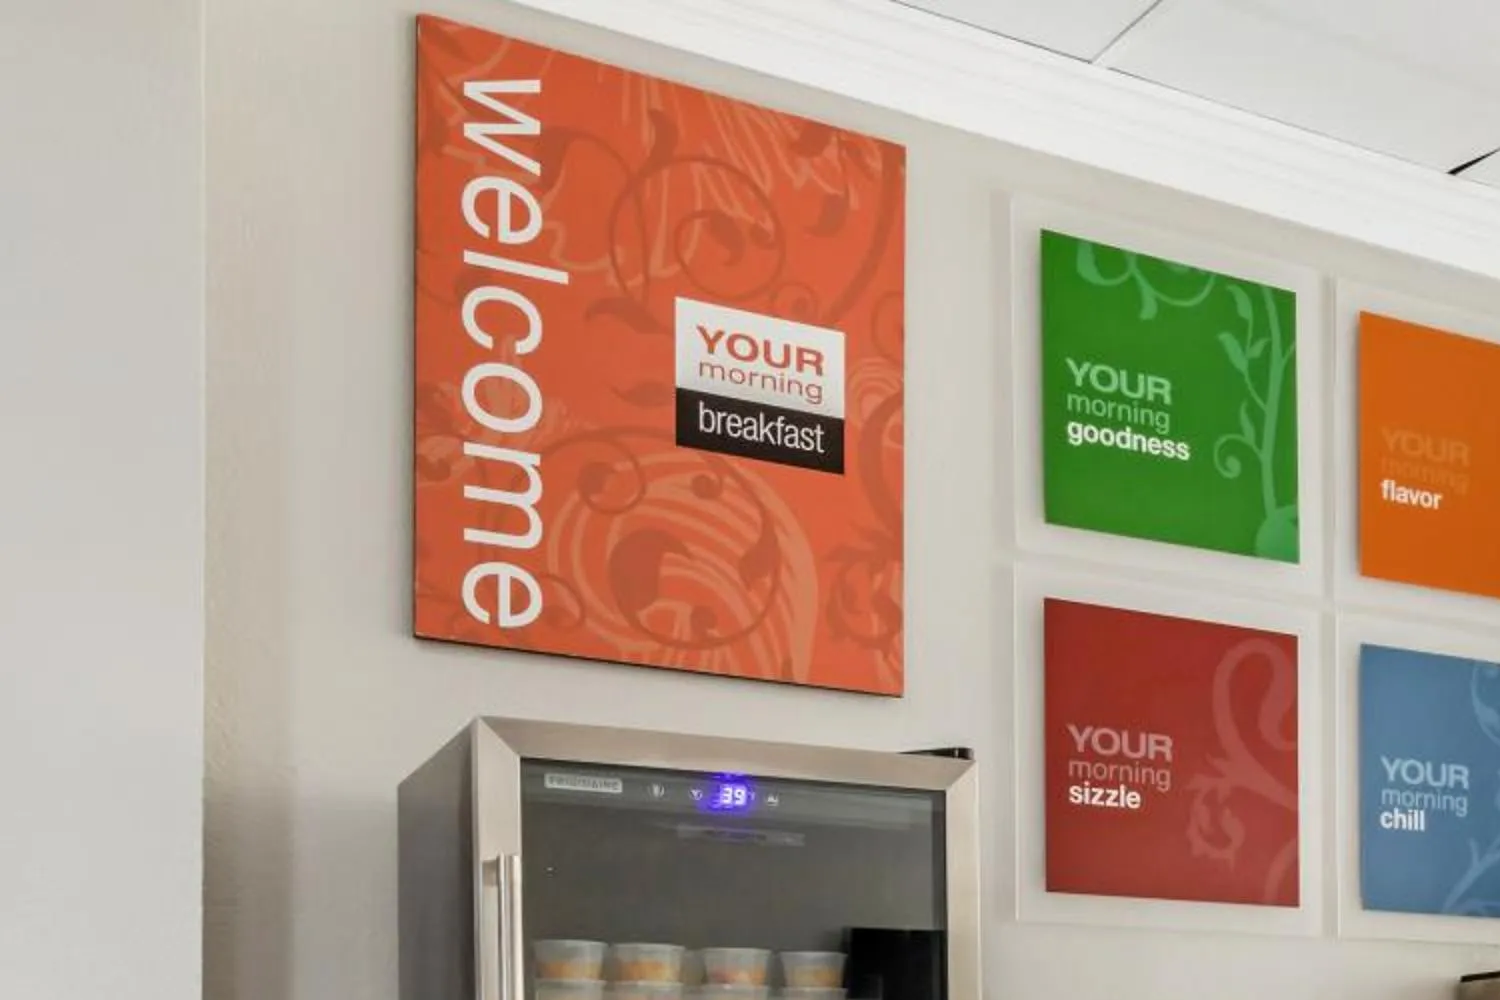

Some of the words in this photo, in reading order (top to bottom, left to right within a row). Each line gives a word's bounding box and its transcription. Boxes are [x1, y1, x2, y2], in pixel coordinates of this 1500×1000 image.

[461, 79, 569, 628] welcome
[697, 324, 824, 376] YOUR
[699, 361, 823, 405] morning
[1065, 357, 1172, 405] YOUR
[699, 400, 825, 453] breakfast
[1067, 393, 1170, 435] morning
[1067, 421, 1190, 460] goodness
[1381, 426, 1470, 467] YOUR
[1380, 479, 1443, 510] flavor
[1066, 723, 1172, 763] YOUR
[1068, 759, 1171, 792] morning
[1381, 755, 1469, 789] YOUR
[719, 785, 748, 806] 39
[1069, 780, 1141, 809] sizzle
[1381, 787, 1468, 817] morning
[1380, 807, 1426, 831] chill
